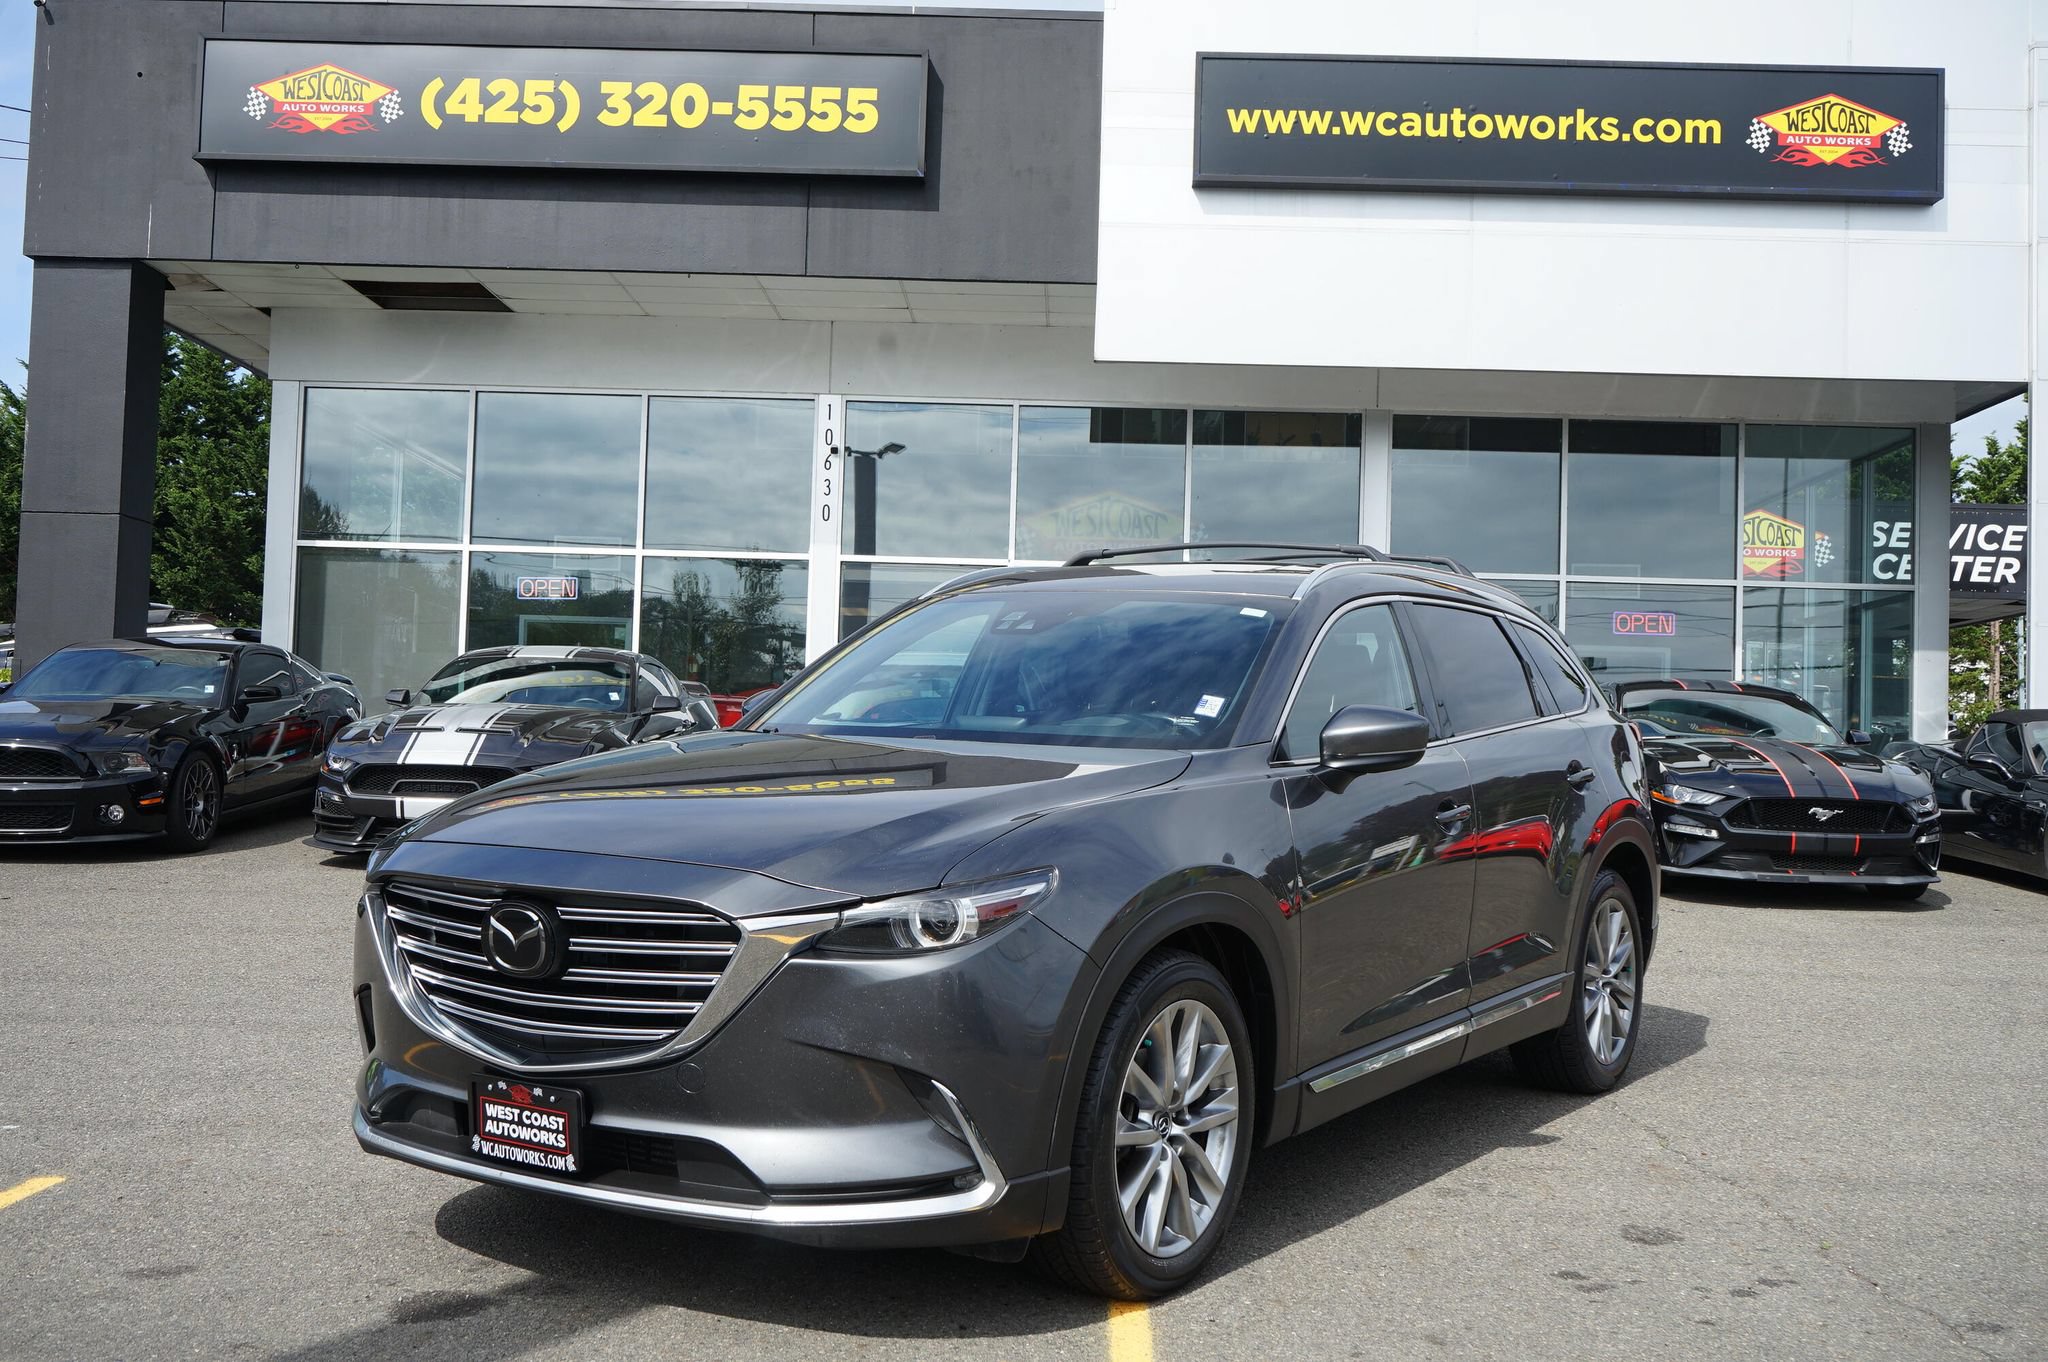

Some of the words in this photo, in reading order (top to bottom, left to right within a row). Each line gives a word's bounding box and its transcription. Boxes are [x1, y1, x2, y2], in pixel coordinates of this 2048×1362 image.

[282, 103, 317, 112] AUTO
[319, 104, 365, 113] WORKS
[420, 76, 580, 133] (425)
[596, 81, 879, 133] 320-5555
[1226, 107, 1721, 144] www.wcautoworks.com
[1786, 135, 1822, 145] AUTO
[1825, 136, 1872, 146] WORKS
[822, 403, 833, 522] 10630
[1755, 548, 1797, 557] WORKS
[520, 579, 575, 597] OPEN
[1616, 614, 1672, 633] OPEN
[485, 1103, 520, 1122] WEST
[522, 1110, 565, 1131] COAST
[485, 1119, 566, 1148] AUTOWORKS
[481, 1140, 566, 1171] WCAUTOWORKS.COM
